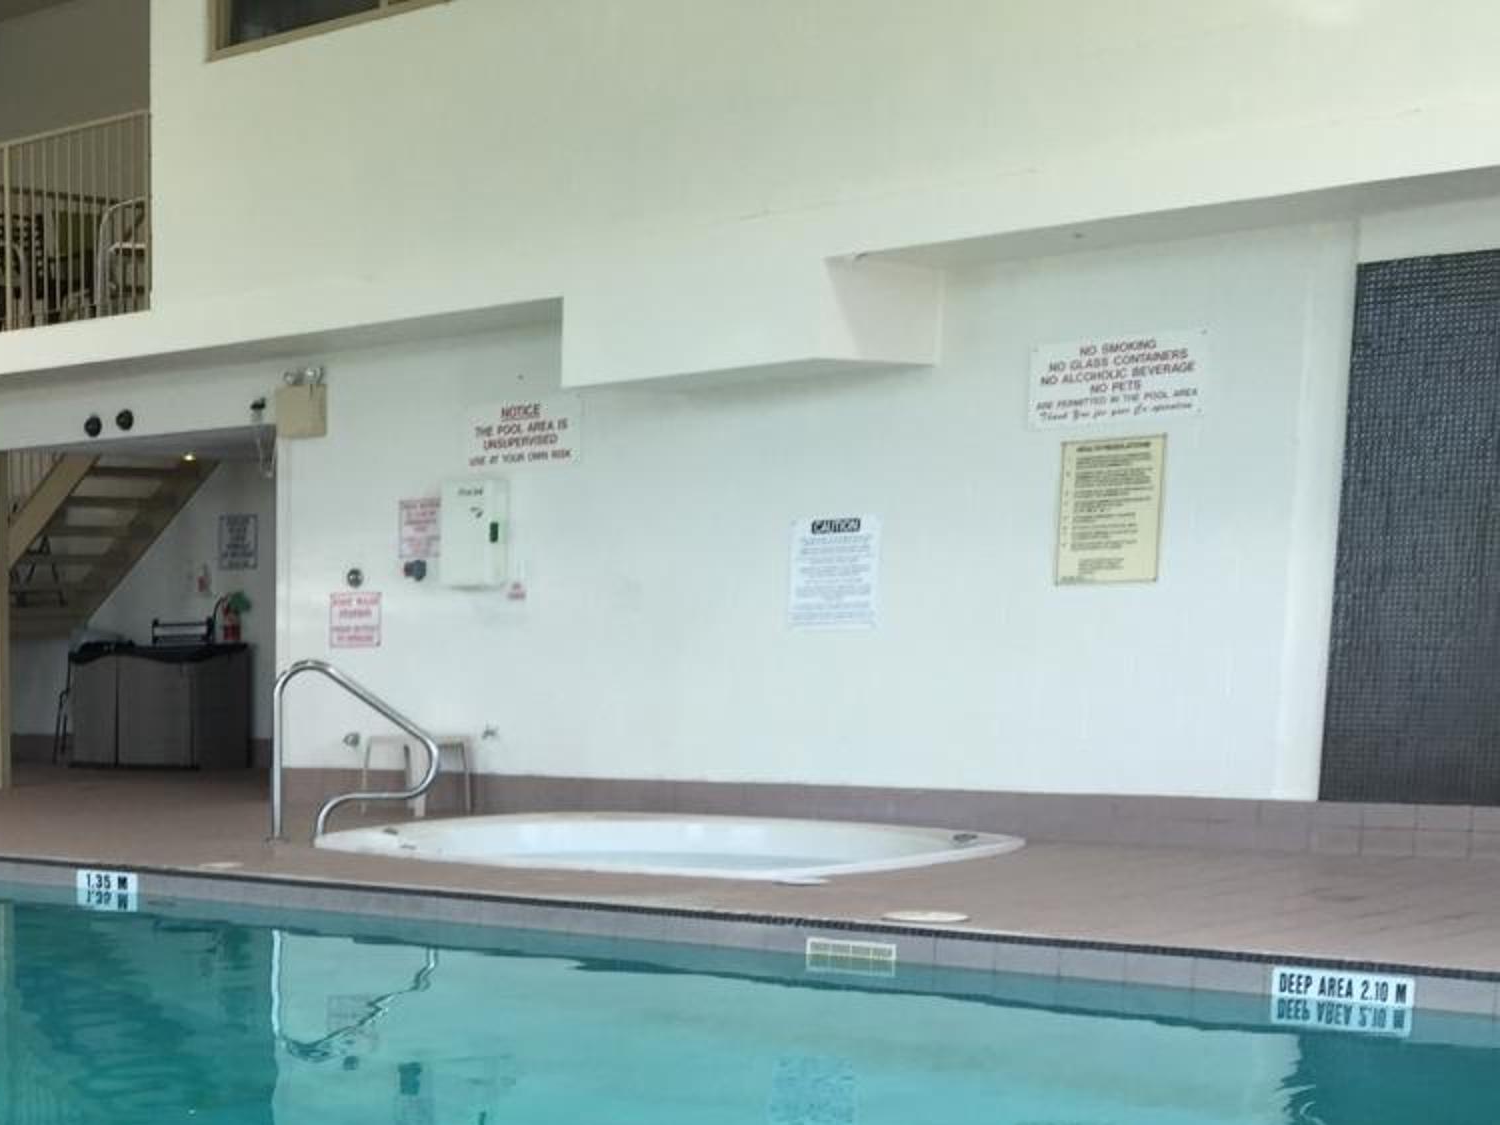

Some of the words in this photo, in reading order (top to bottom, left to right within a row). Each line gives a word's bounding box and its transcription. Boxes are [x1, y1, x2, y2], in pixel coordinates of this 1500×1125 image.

[1080, 346, 1097, 356] NO
[1102, 339, 1156, 353] SMOKING
[1049, 361, 1066, 372] NO
[1070, 357, 1109, 370] GLASS
[1113, 348, 1188, 367] CONTAINERS
[1041, 374, 1059, 385] NO
[1062, 368, 1128, 384] ALCOHOLIC
[1090, 383, 1108, 394] NO
[1112, 380, 1141, 392] PETS
[501, 403, 541, 417] NOTICE
[474, 426, 493, 438] THE
[497, 423, 522, 436] POOL
[527, 420, 554, 433] AREA
[557, 418, 568, 430] IS
[483, 433, 559, 451] UNSUPERVISED
[813, 519, 860, 533] CAUTION
[86, 873, 112, 889] 1.35
[117, 876, 129, 890] M
[1279, 973, 1313, 995] DEEP
[1318, 976, 1354, 999] AREA
[1361, 980, 1389, 1003] 2.10
[1395, 983, 1408, 1004] M
